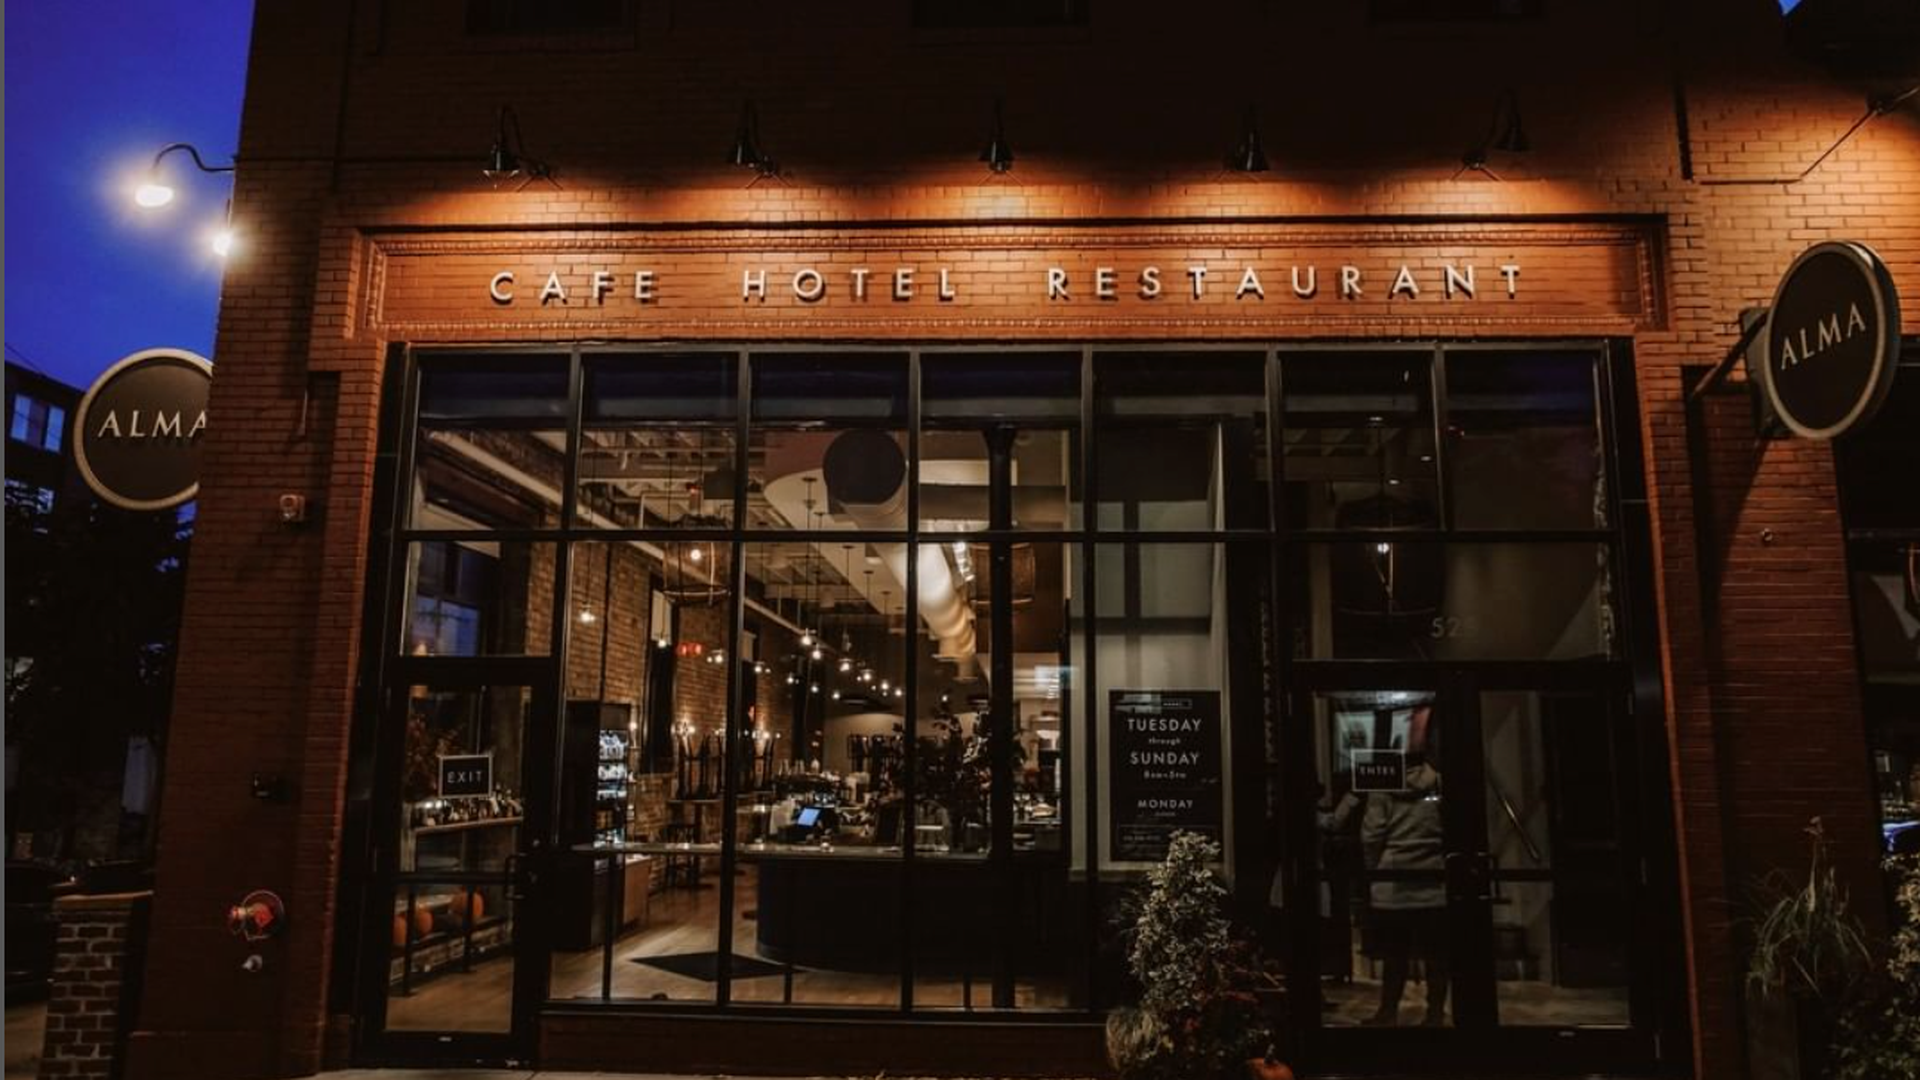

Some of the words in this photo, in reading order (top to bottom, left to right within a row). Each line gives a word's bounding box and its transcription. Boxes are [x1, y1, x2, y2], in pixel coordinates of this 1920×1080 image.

[489, 269, 655, 300] CAFE
[742, 268, 956, 300] HOTEL
[1047, 264, 1521, 299] RESTAURANT
[1780, 301, 1867, 370] ALMA
[97, 409, 207, 438] ALMA
[1127, 718, 1202, 732] TUESDAY
[1148, 736, 1181, 747] through
[1129, 751, 1200, 766] SUNDAY
[447, 770, 482, 784] EXIT
[1137, 799, 1194, 809] MONDAY
